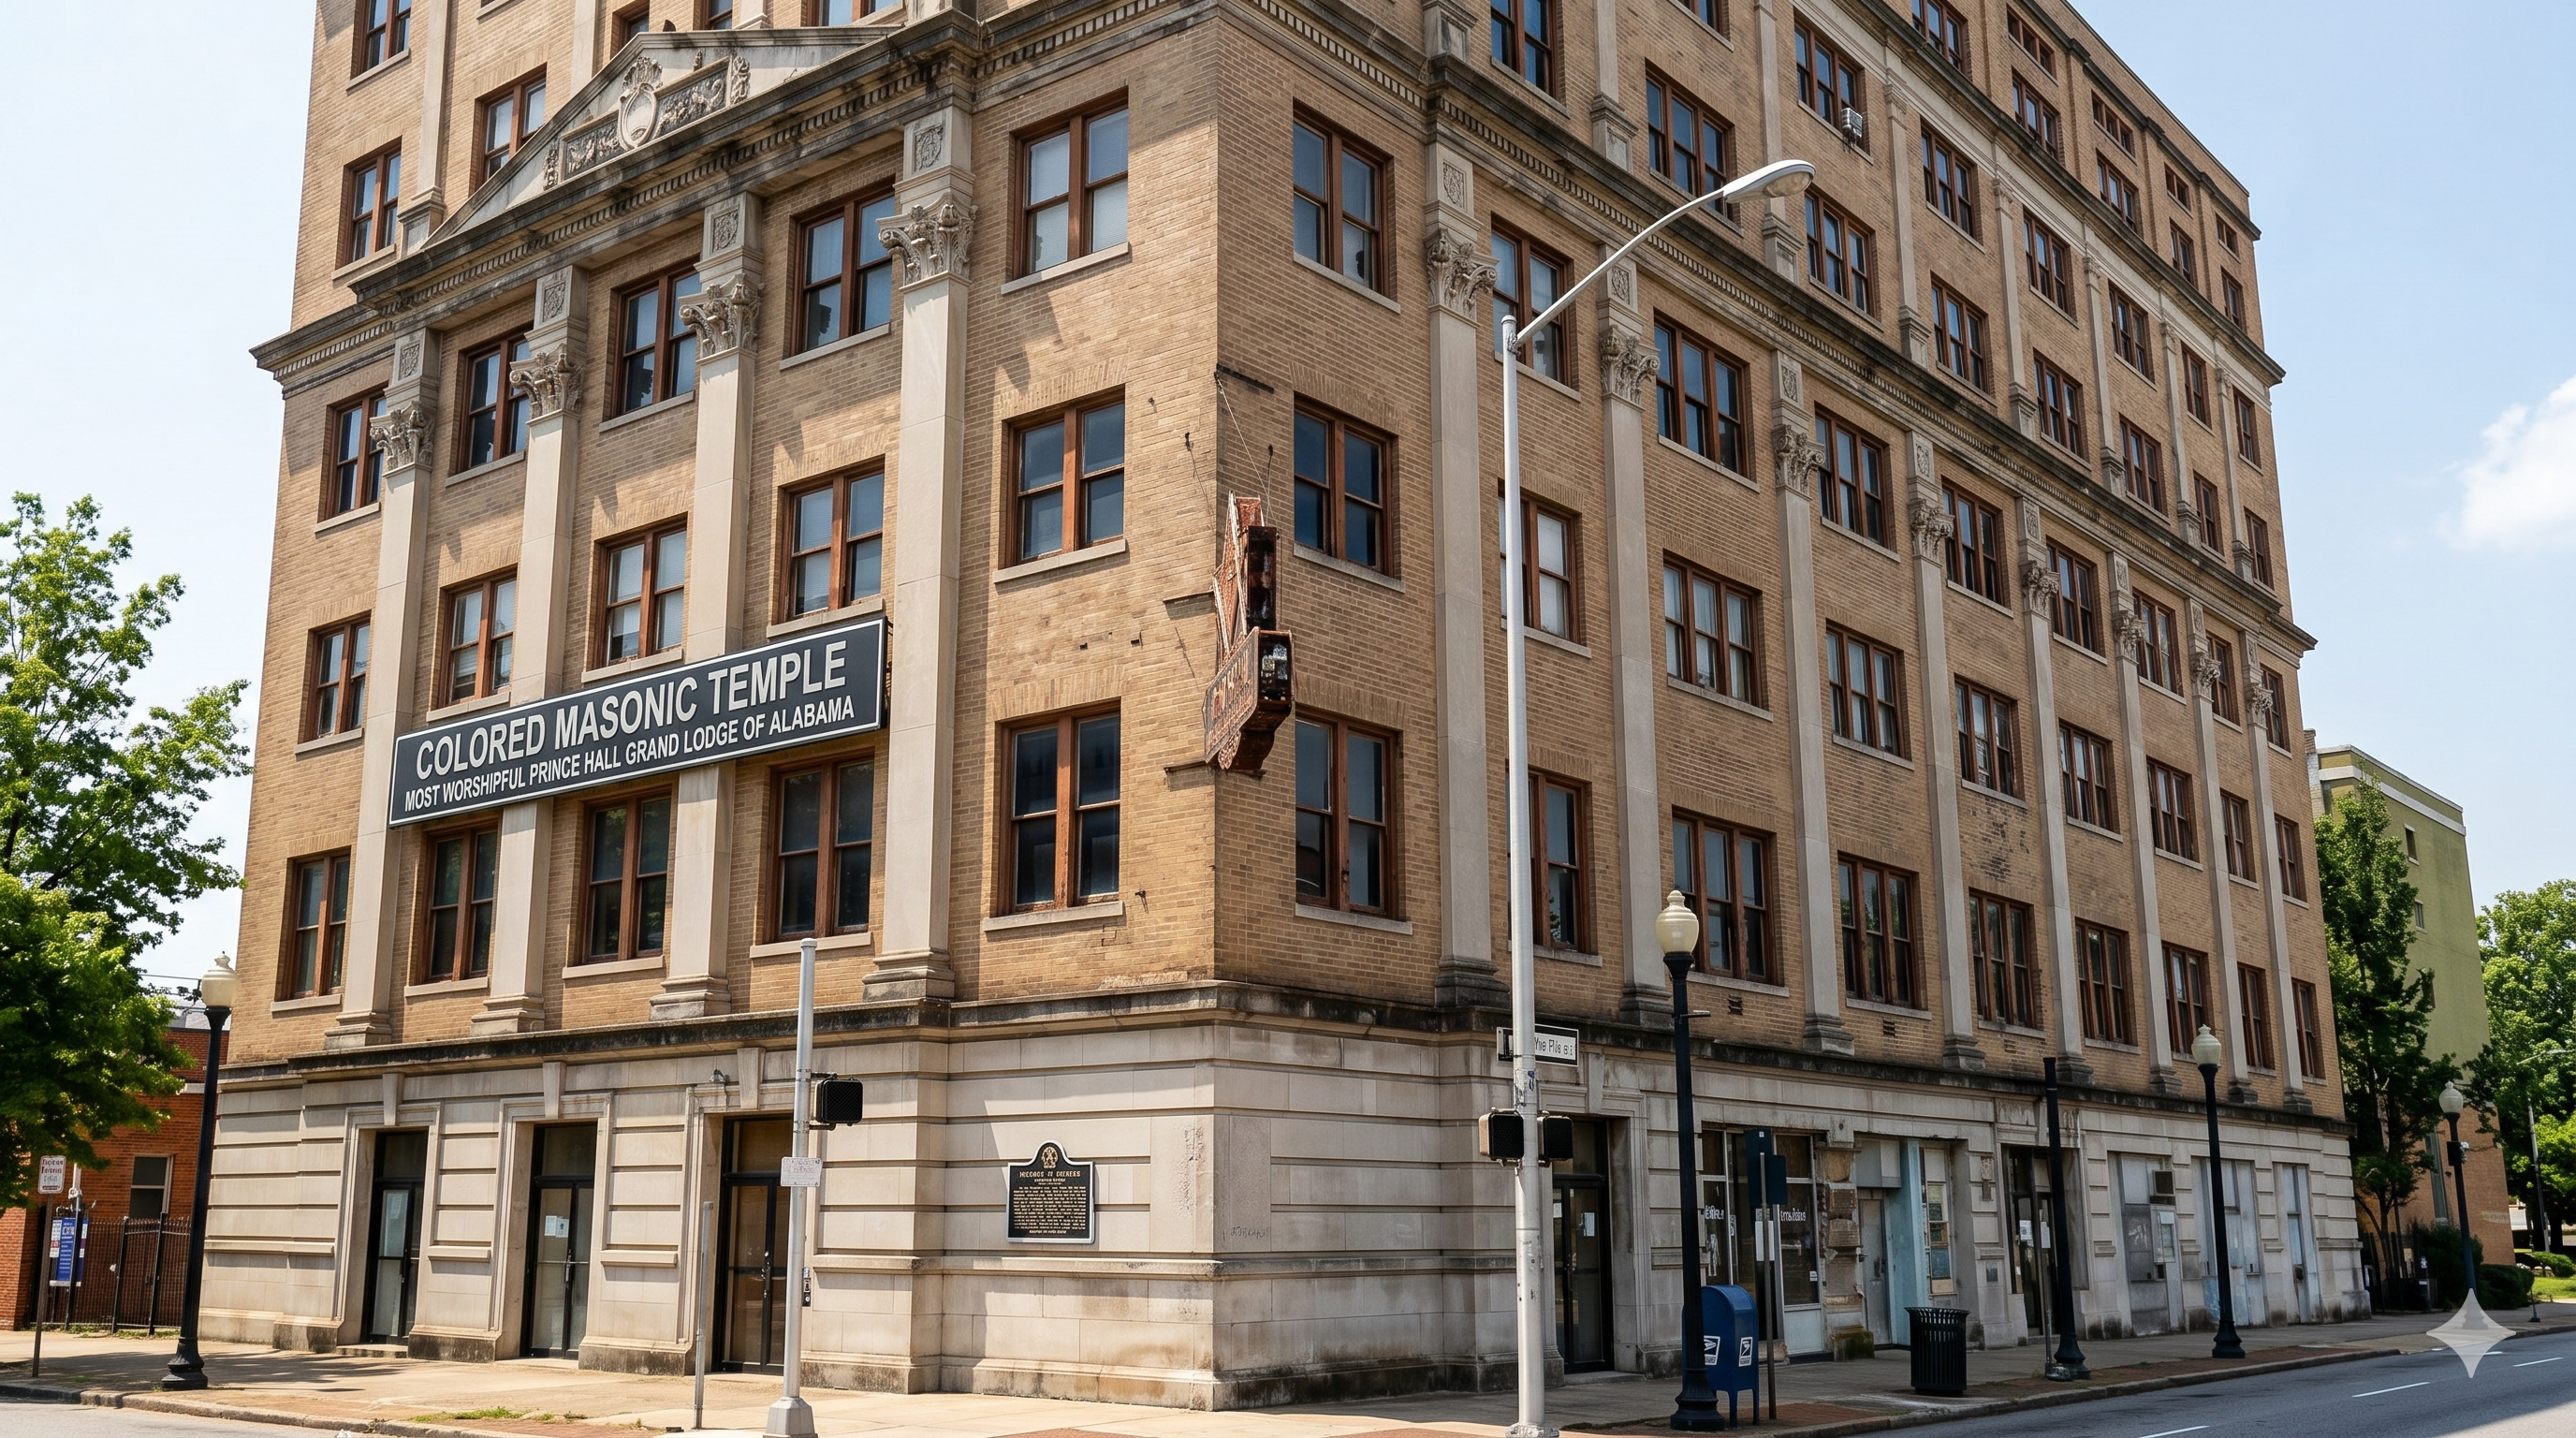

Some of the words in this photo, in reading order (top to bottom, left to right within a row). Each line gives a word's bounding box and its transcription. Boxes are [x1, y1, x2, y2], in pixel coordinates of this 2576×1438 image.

[404, 785, 441, 813] MOST
[442, 767, 526, 804] WORSHIPFUL
[529, 753, 581, 786] PRINCE
[583, 745, 622, 774] HALL
[625, 733, 680, 766] GRAND
[683, 718, 739, 754] LODGE
[742, 712, 766, 741] OF
[768, 695, 855, 736] ALABAMA
[416, 714, 546, 780] COLORED
[554, 676, 698, 750] MASONIC
[708, 639, 847, 715] TEMPLE
